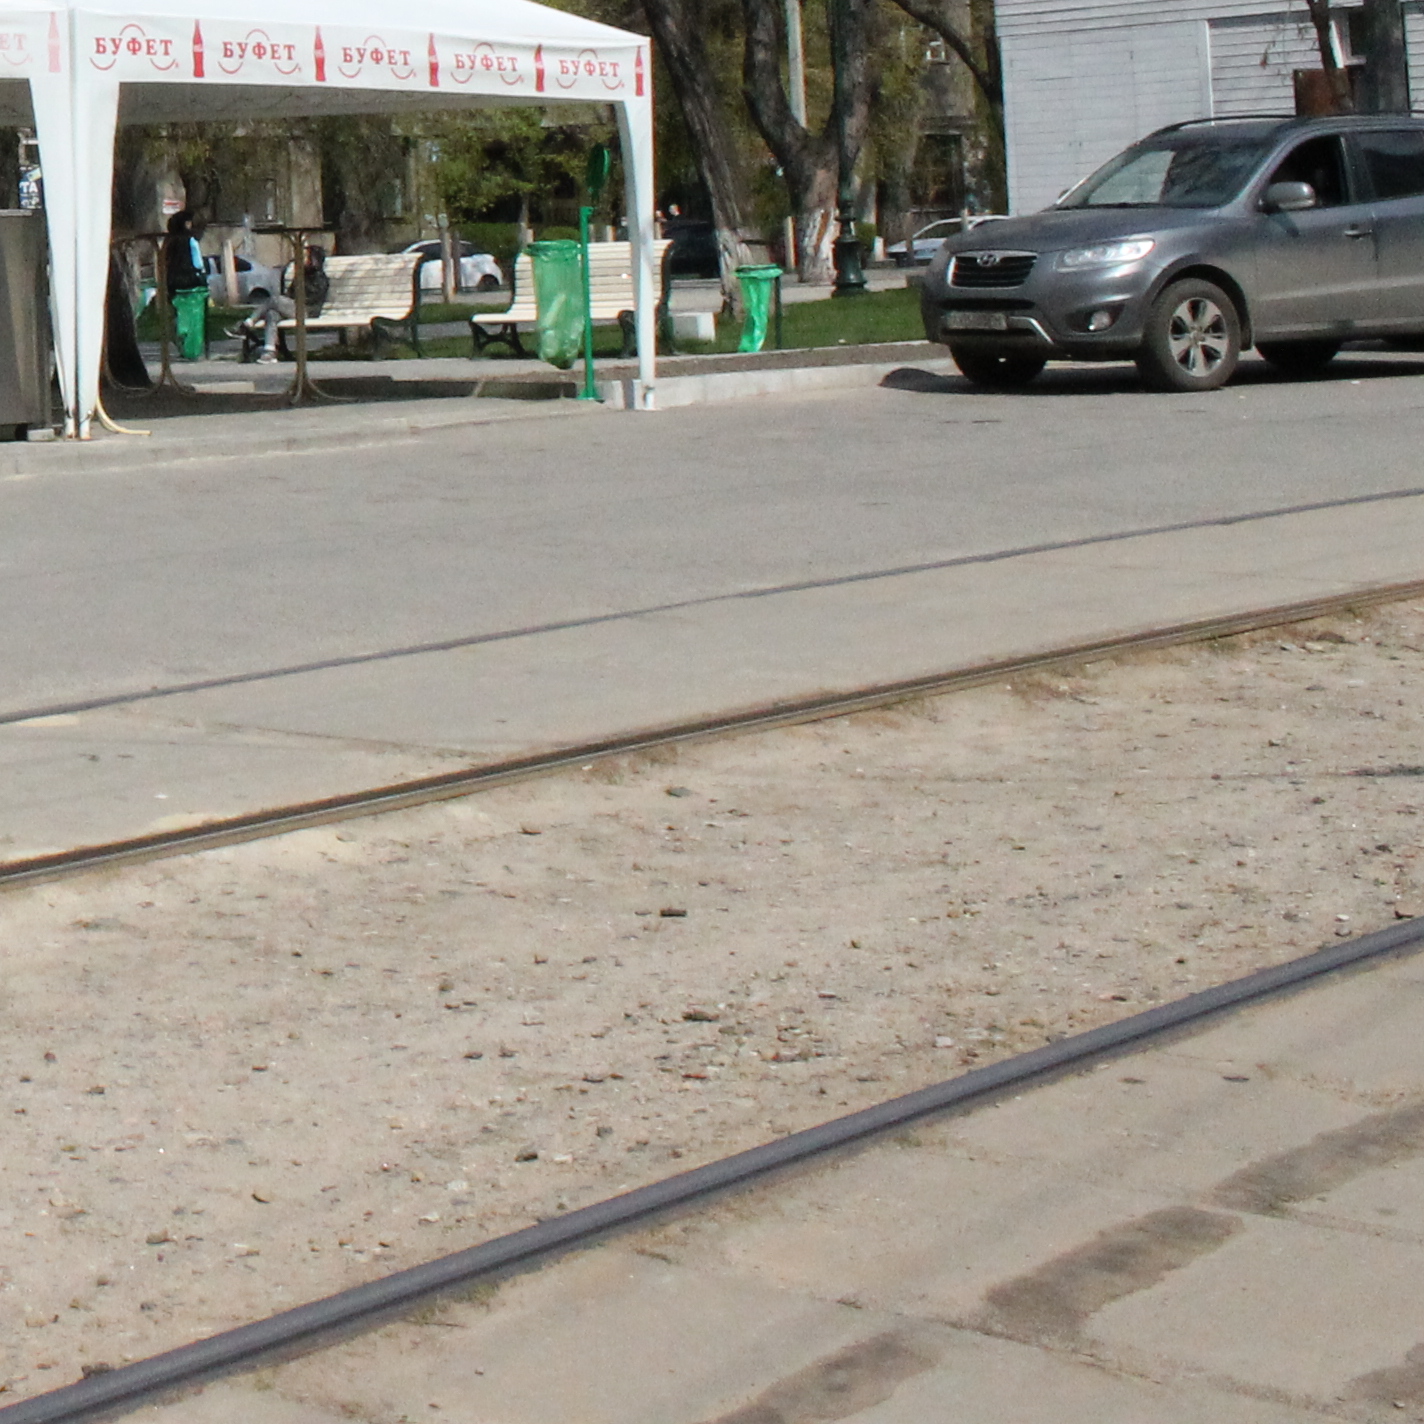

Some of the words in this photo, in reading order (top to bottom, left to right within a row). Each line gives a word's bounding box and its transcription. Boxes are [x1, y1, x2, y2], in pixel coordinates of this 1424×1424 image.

[95, 37, 173, 57] БУФЕТ
[222, 41, 296, 61] БУФЕТ
[342, 47, 411, 67] БУФЕТ
[454, 54, 519, 73] БУФЕТ
[558, 59, 621, 78] БУФЕТ
